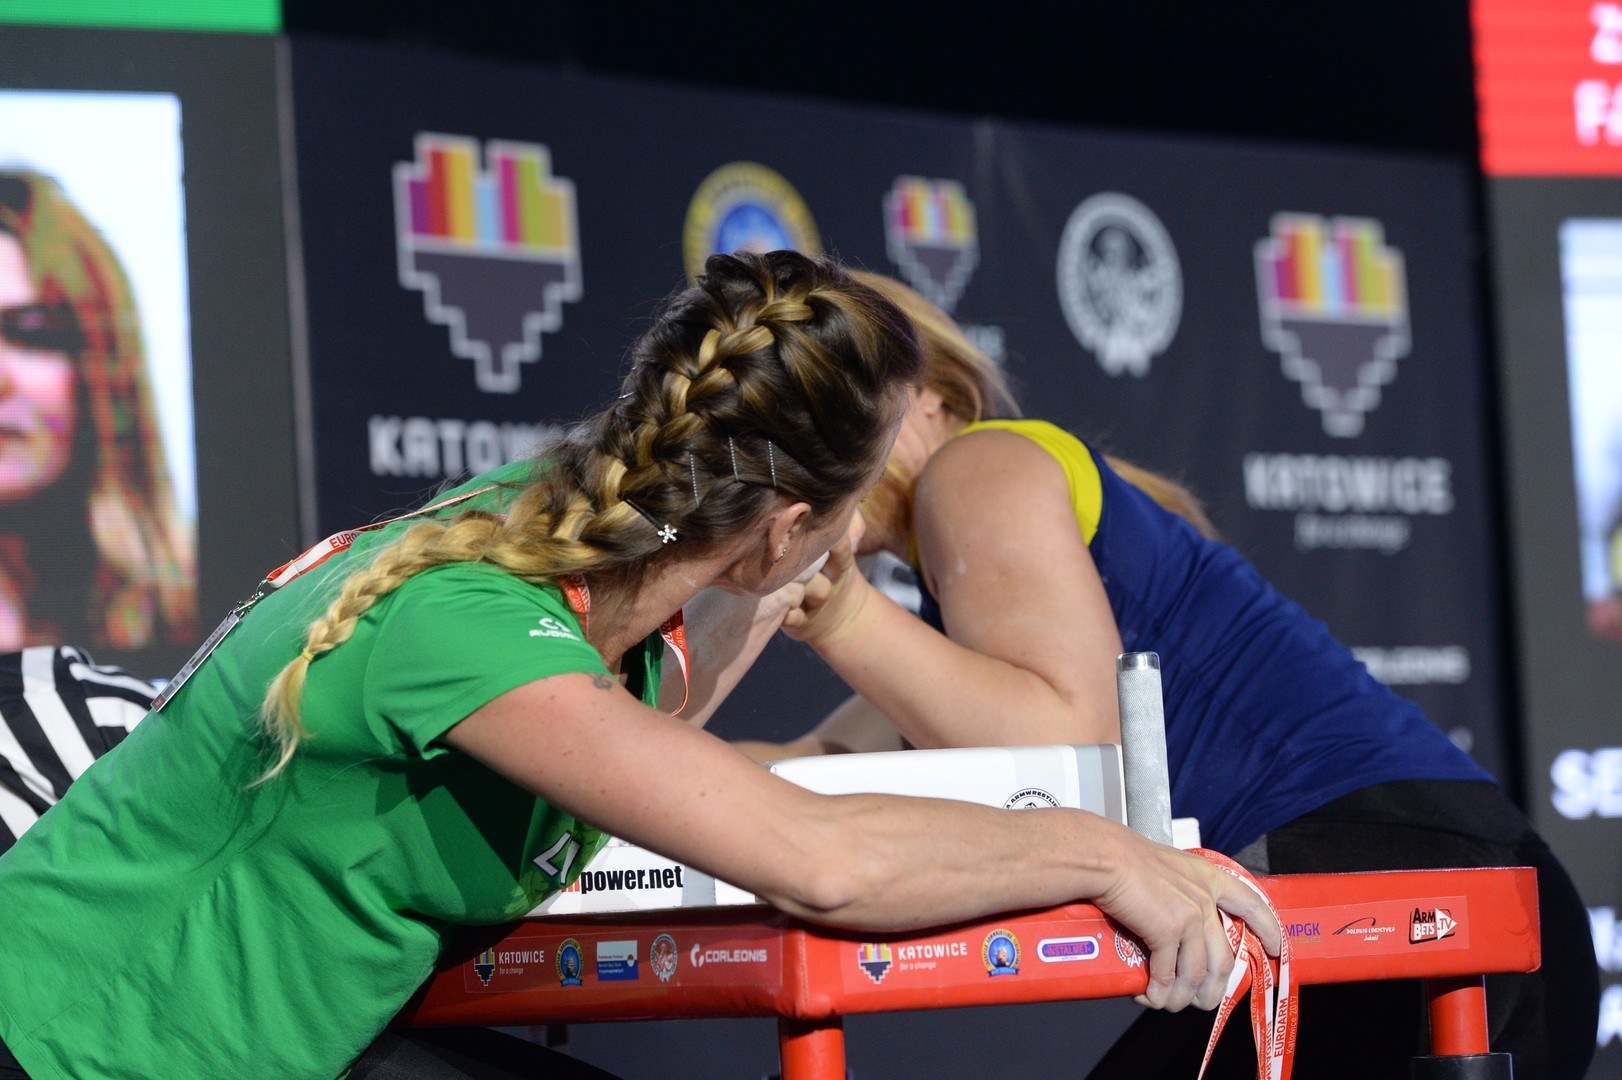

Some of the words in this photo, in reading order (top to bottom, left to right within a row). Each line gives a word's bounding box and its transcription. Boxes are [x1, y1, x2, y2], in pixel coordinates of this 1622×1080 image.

[367, 414, 597, 478] KATOW
[1243, 453, 1454, 514] KATOWICE
[1412, 907, 1437, 924] ARM
[1413, 922, 1436, 941] BETS
[498, 950, 545, 964] KATOWICE
[705, 949, 768, 963] CORLEONIS
[897, 942, 968, 960] KATOWICE
[1289, 995, 1298, 1016] 2017
[1274, 997, 1288, 1058] EUROARM
[1285, 1017, 1297, 1055] Katowice
